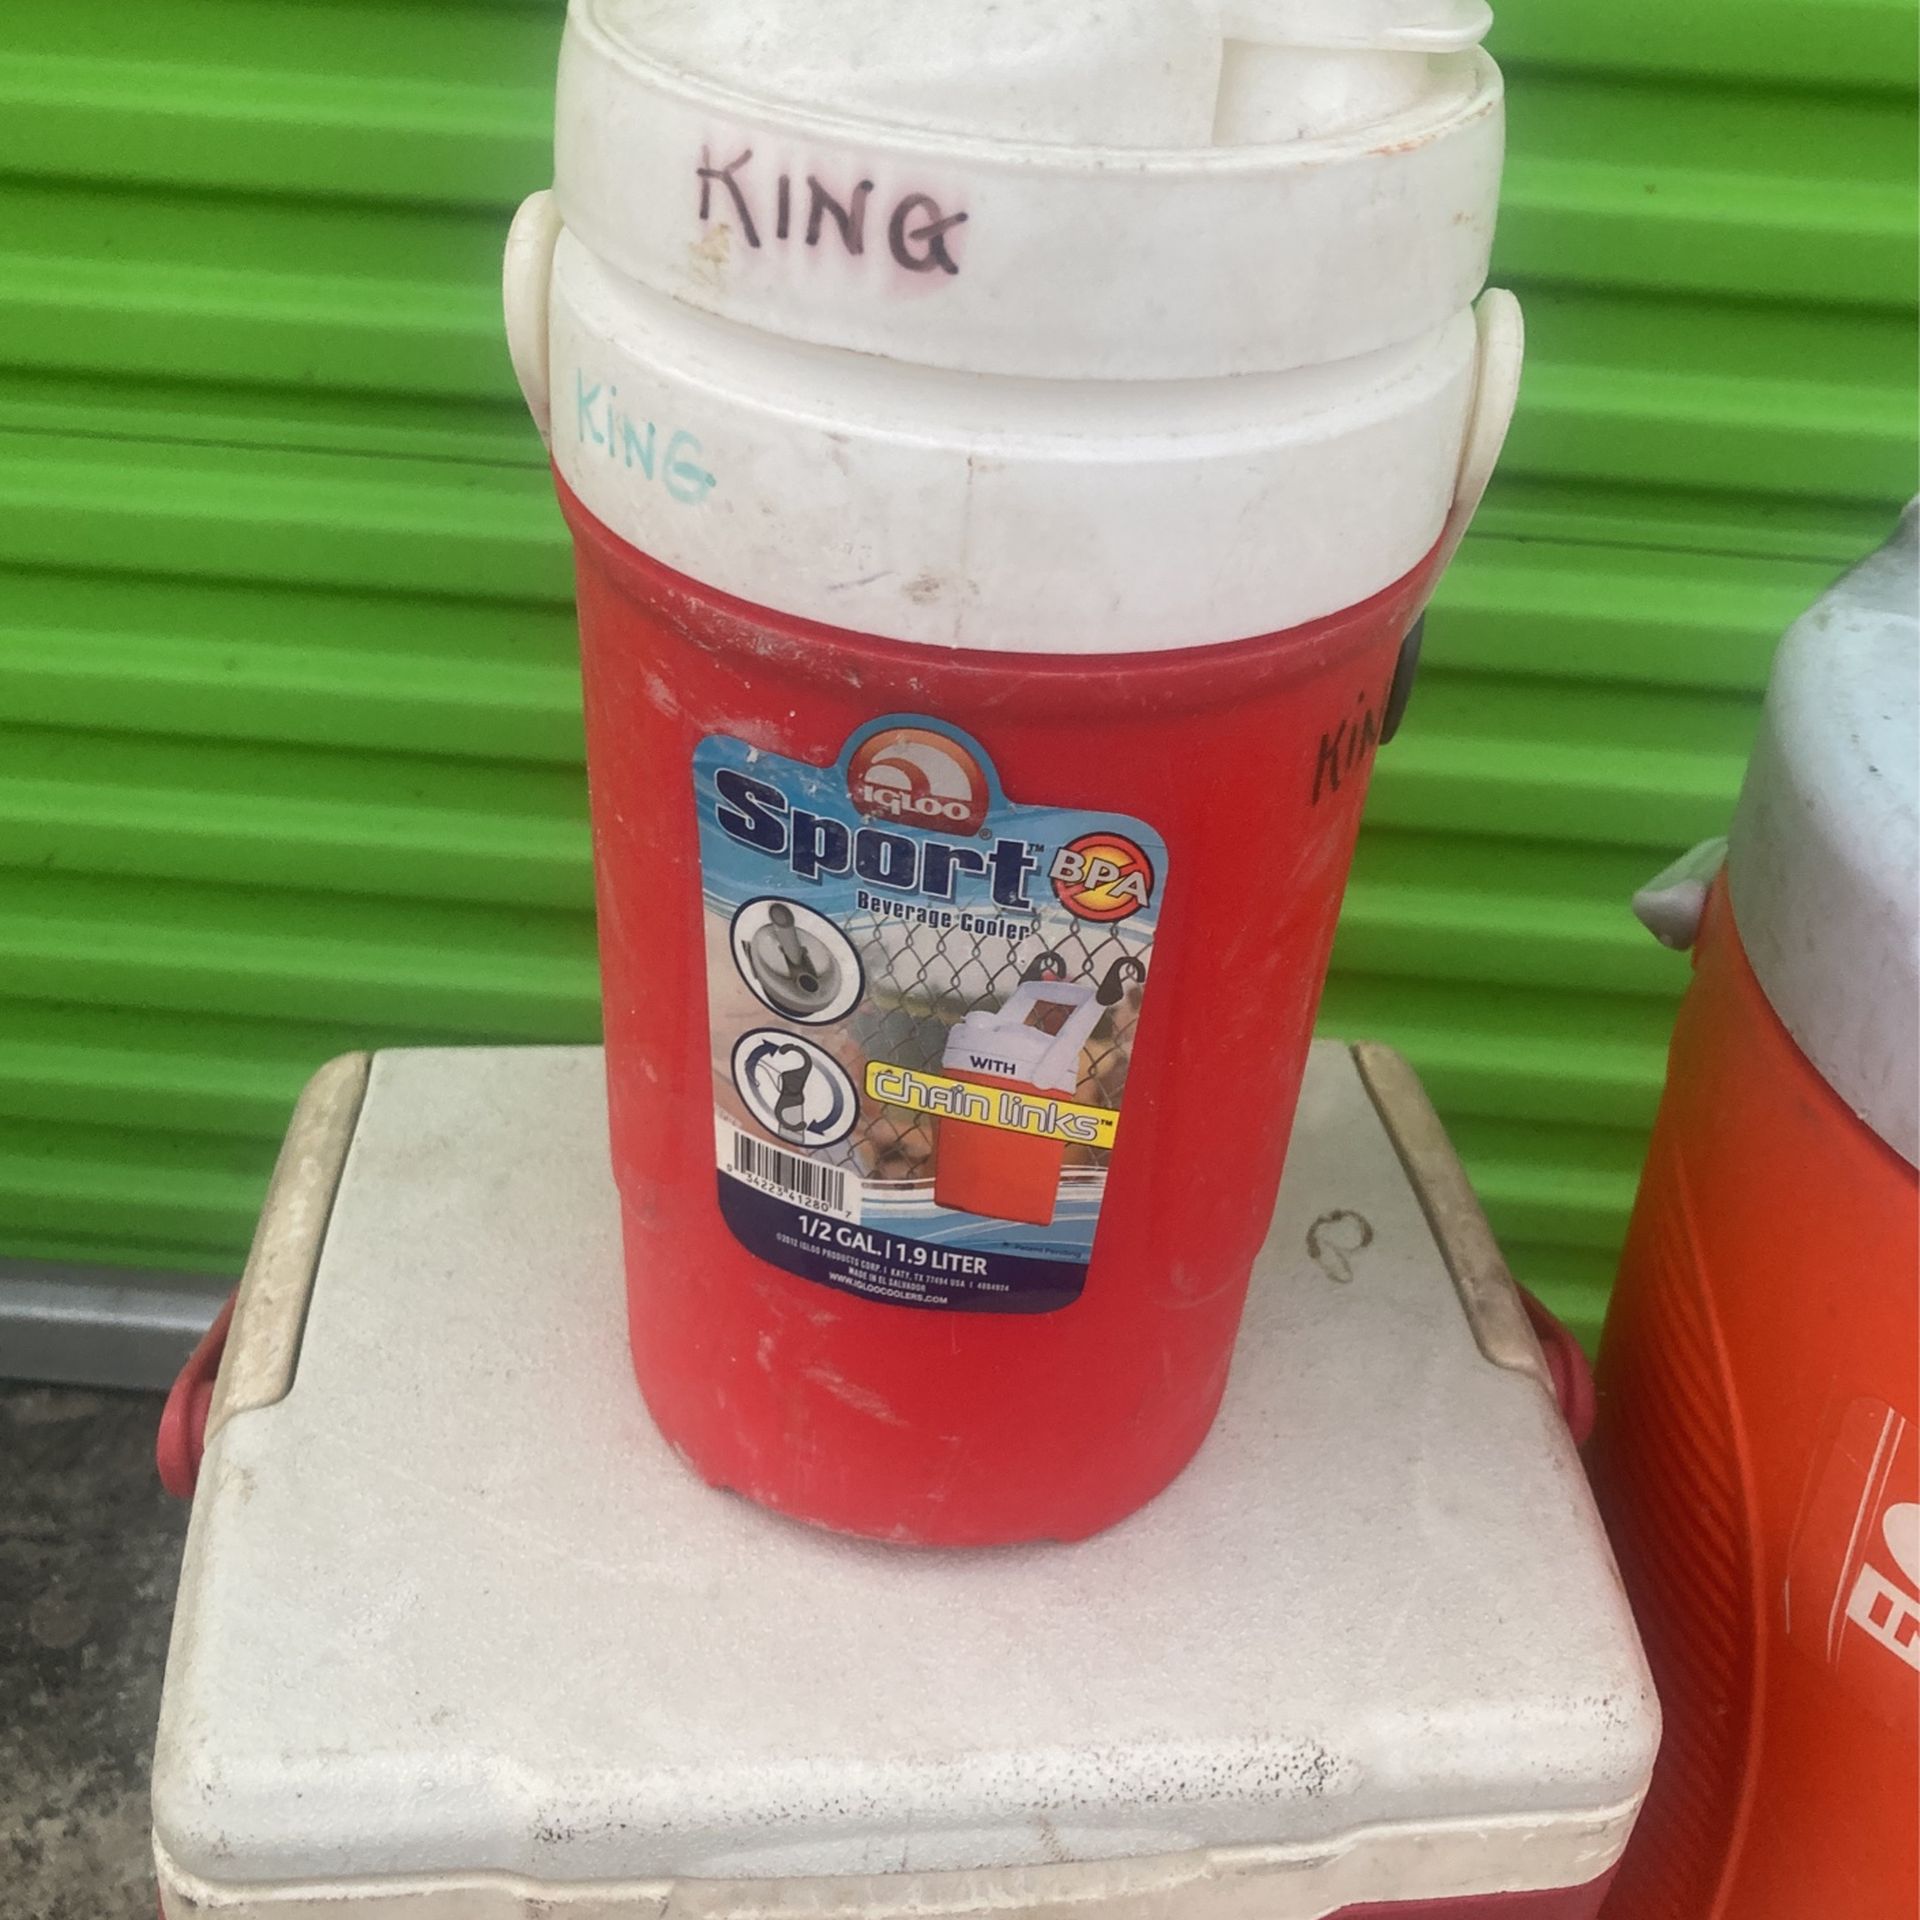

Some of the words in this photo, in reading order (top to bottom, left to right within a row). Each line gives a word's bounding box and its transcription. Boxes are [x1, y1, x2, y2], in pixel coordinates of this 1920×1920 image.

[696, 144, 969, 275] KING
[1048, 847, 1151, 909] BPA
[857, 889, 952, 929] Beverage
[960, 912, 1030, 941] Cooler
[969, 1055, 1016, 1076] WITH
[999, 1093, 1099, 1141] links
[798, 1215, 832, 1241] 1/2
[836, 1227, 882, 1256] GAL.
[896, 1243, 928, 1266] 1.9
[931, 1250, 988, 1275] LITER
